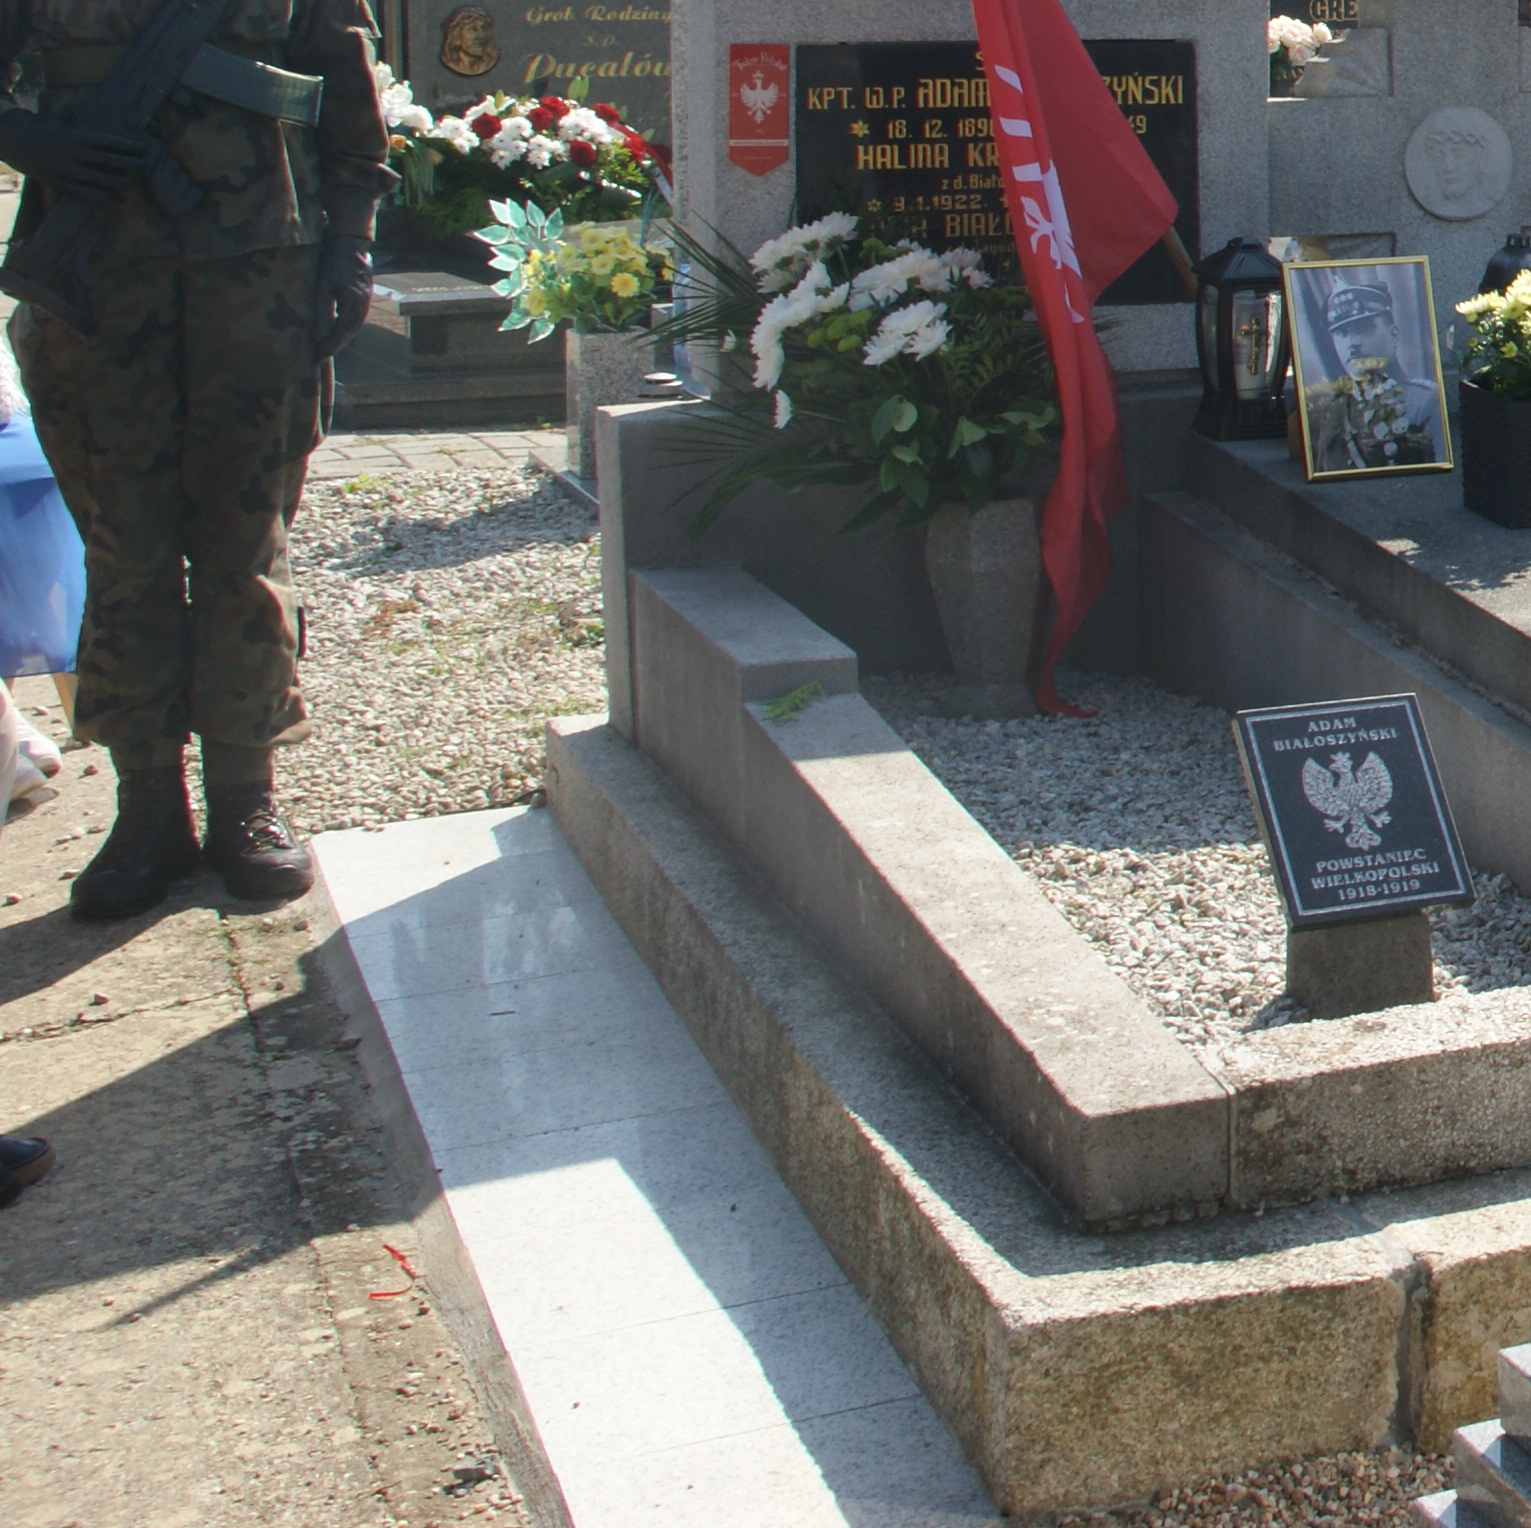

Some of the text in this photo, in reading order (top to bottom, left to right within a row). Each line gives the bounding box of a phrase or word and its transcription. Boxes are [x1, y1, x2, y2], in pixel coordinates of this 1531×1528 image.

[806, 87, 855, 109] KPT.
[917, 78, 991, 109] ADAM
[923, 120, 948, 139] 12.
[856, 143, 949, 170] HALINA
[1307, 716, 1357, 733] ADAM
[1273, 727, 1398, 752] BIAŁOSZYŃSKI
[1316, 848, 1426, 872] POWSTANIEC
[1311, 861, 1441, 890] WIELKOPOLSKI
